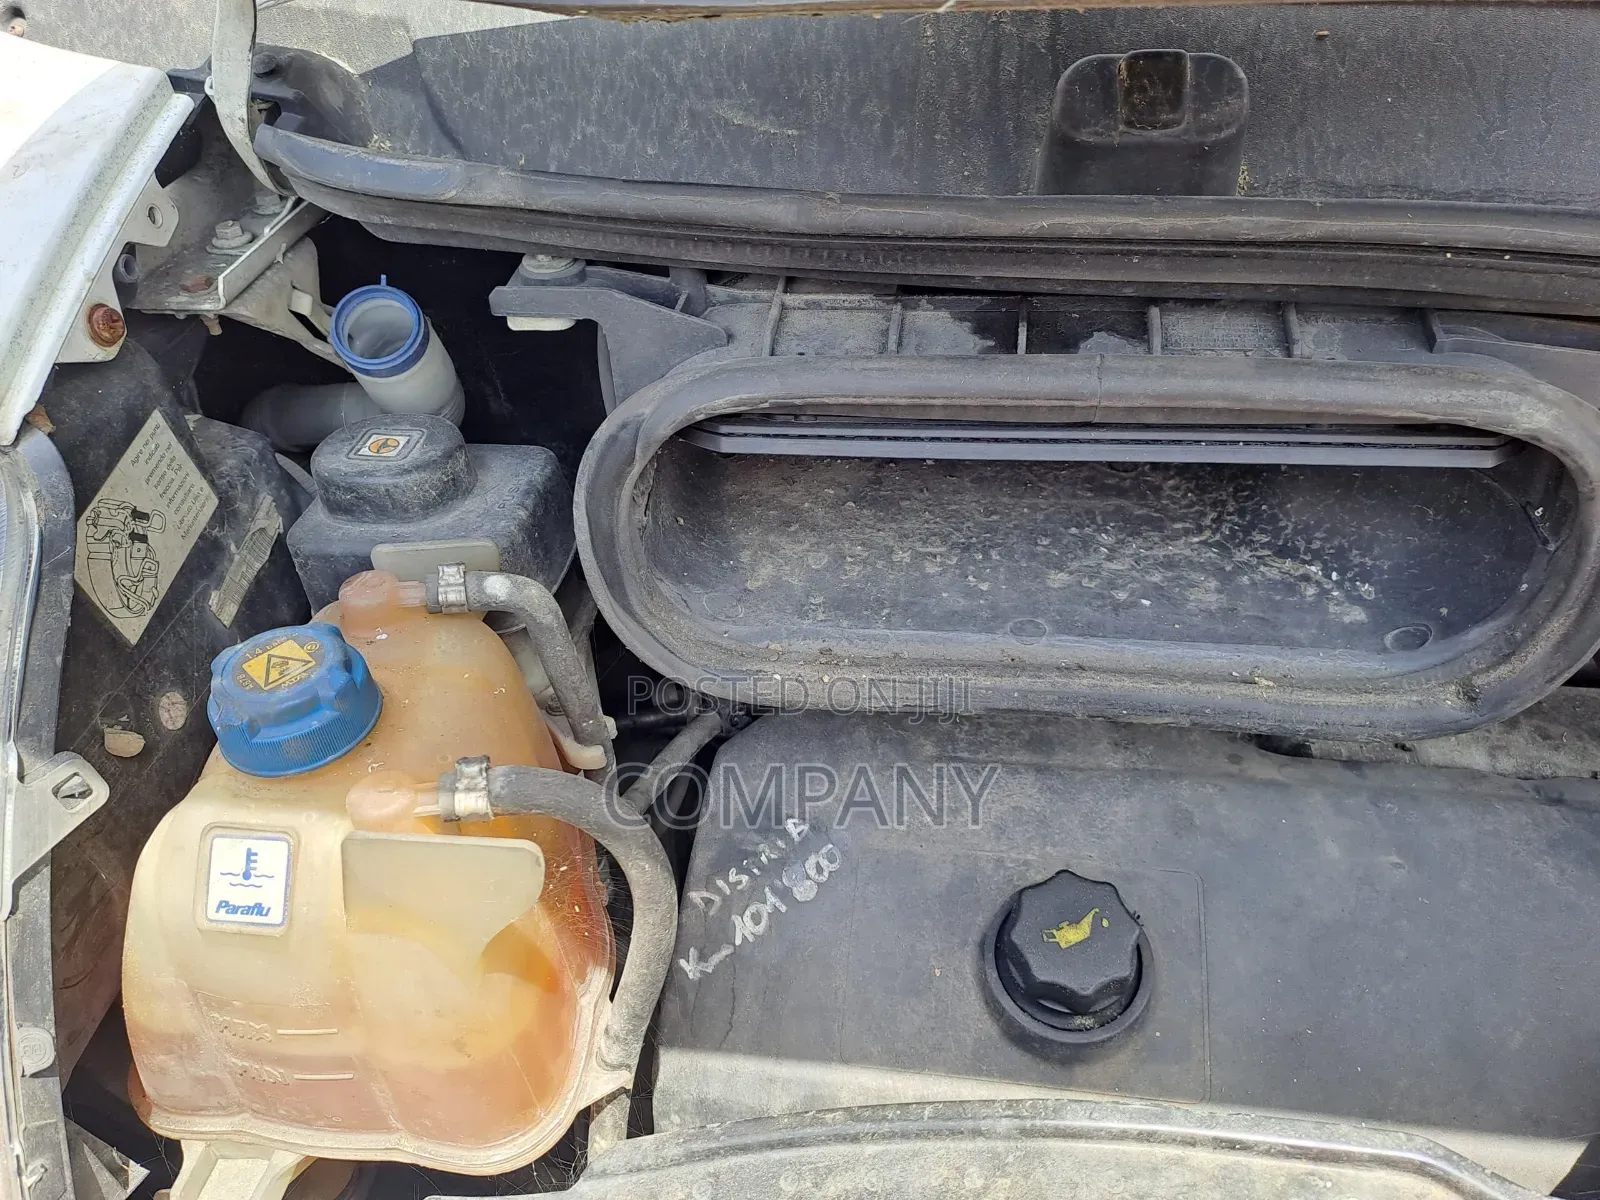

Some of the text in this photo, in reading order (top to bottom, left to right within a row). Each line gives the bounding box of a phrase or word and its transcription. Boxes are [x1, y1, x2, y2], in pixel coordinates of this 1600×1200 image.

[130, 448, 143, 468] Agire
[149, 422, 161, 441] punti
[144, 442, 161, 465] indicati
[144, 451, 167, 486] premendo
[215, 899, 272, 917] Paraflu
